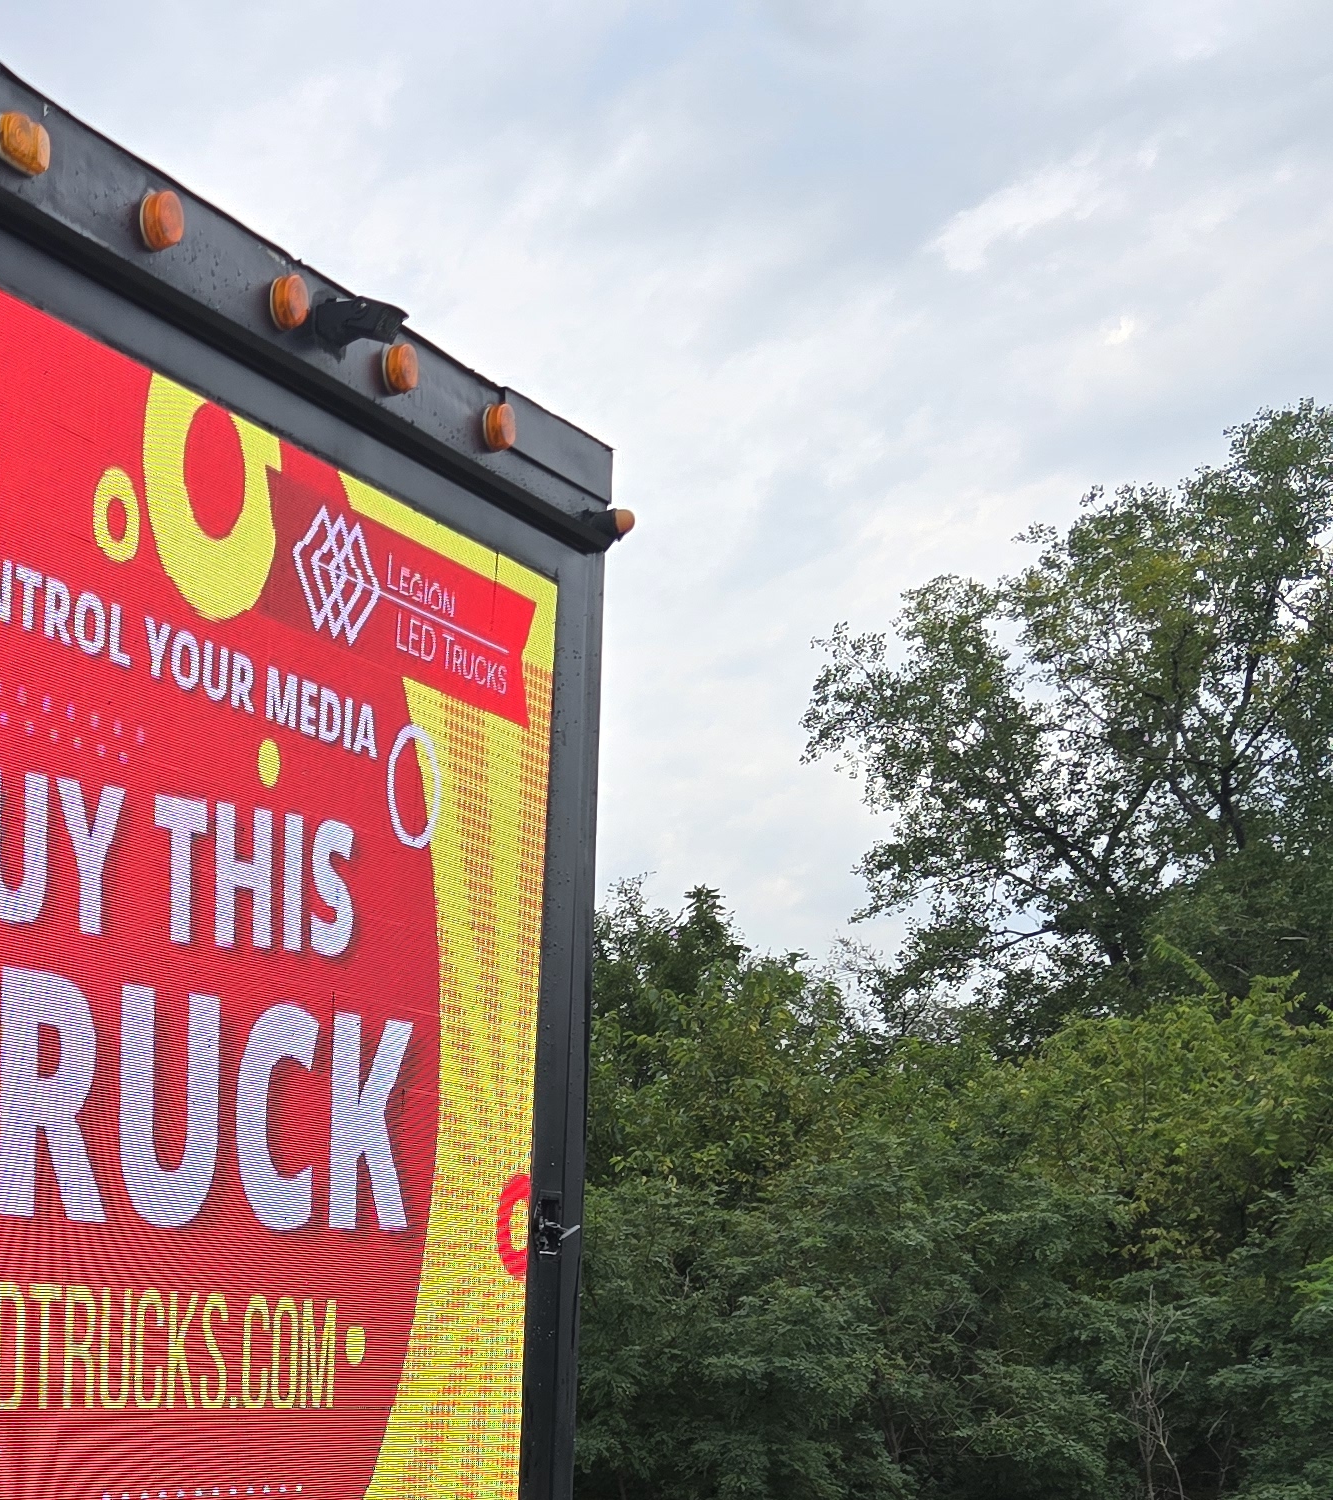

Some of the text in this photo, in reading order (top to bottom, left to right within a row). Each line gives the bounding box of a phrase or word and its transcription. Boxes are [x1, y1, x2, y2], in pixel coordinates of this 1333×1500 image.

[386, 552, 456, 618] LEGION
[396, 609, 436, 662] LED
[144, 614, 255, 713] YOUR
[265, 667, 379, 760] MEDIA
[153, 794, 355, 958] THIS
